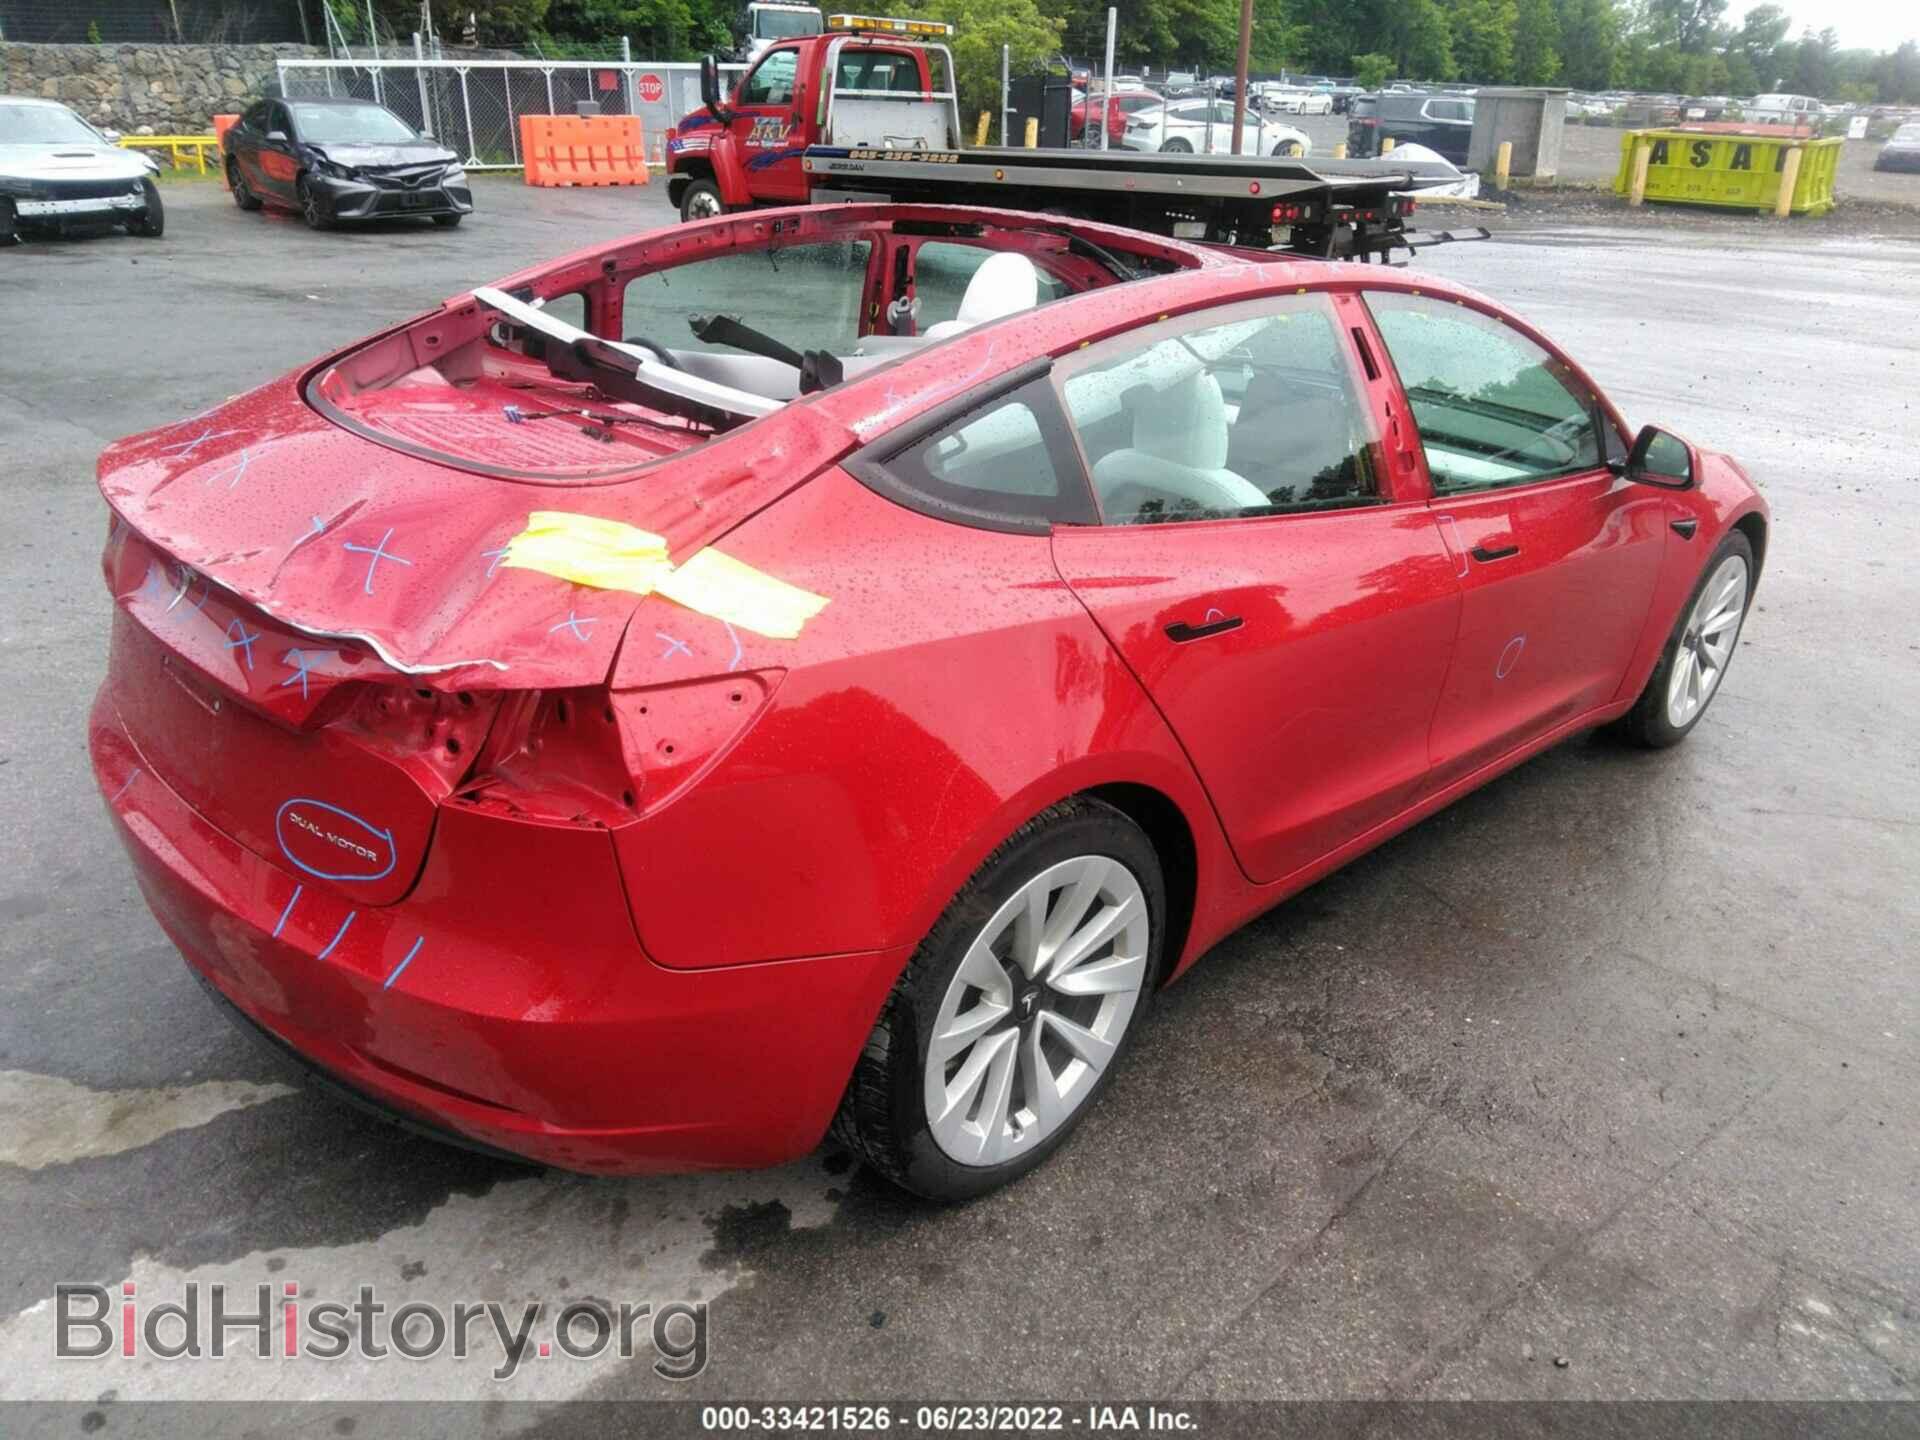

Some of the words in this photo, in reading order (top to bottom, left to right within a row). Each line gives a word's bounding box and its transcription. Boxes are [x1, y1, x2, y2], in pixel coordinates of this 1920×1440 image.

[639, 82, 662, 93] STOP
[287, 811, 323, 837] DUAL
[325, 832, 377, 862] MOTOR
